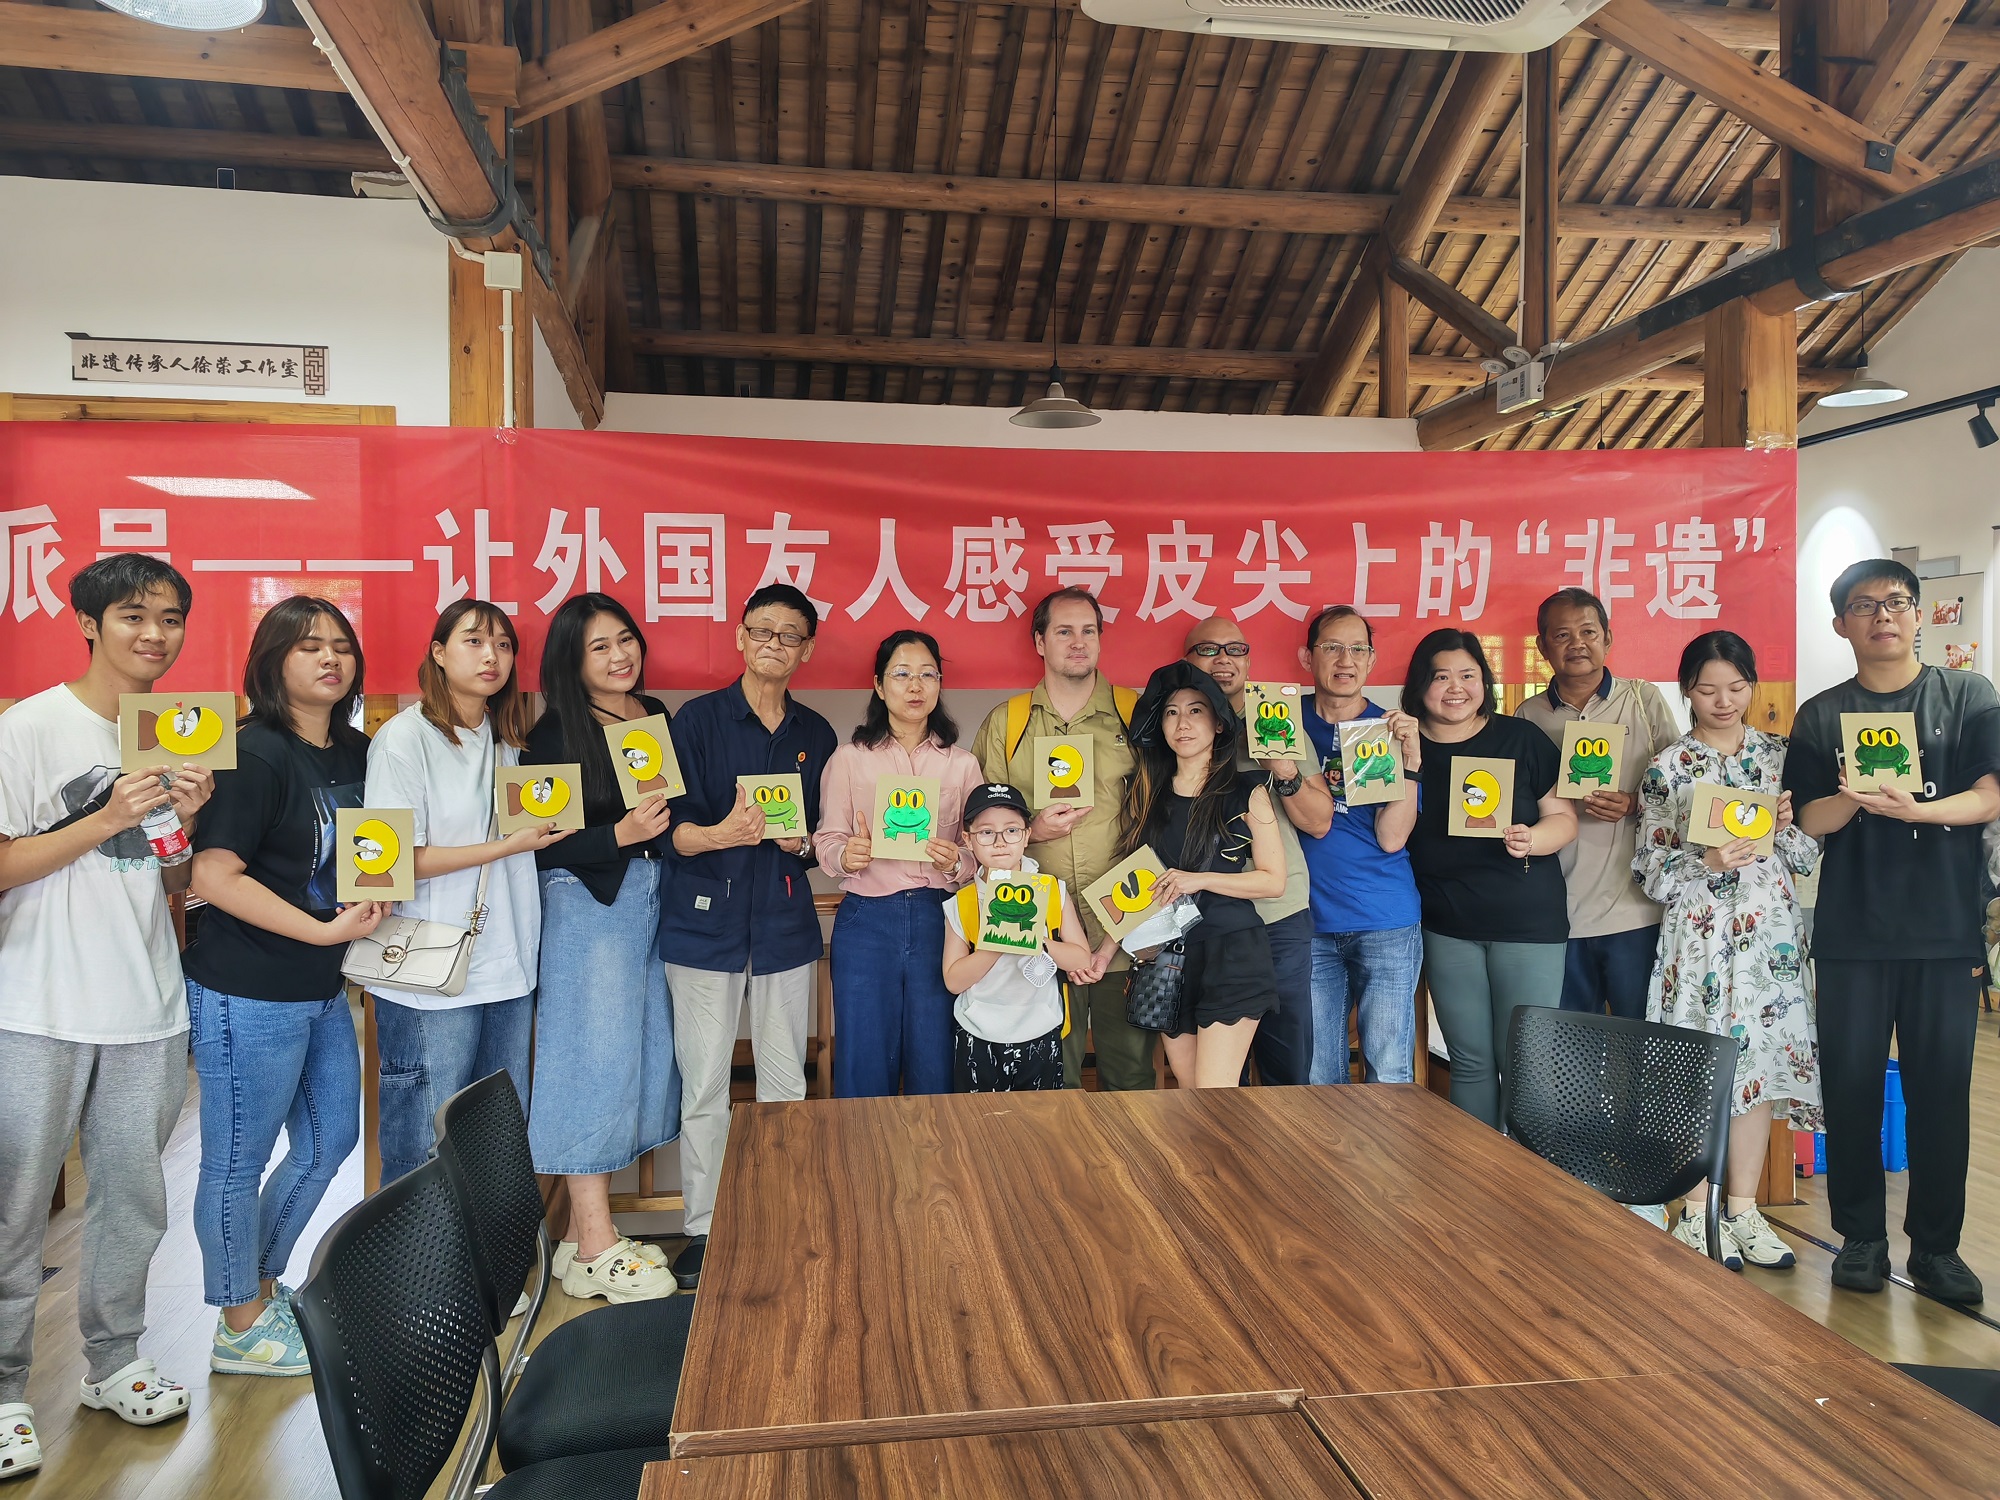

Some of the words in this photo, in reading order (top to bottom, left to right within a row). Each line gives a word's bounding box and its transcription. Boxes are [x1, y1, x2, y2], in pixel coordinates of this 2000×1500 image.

[81, 353, 299, 379] 非遗传承人徐荣工作室
[987, 792, 1012, 800] adidas
